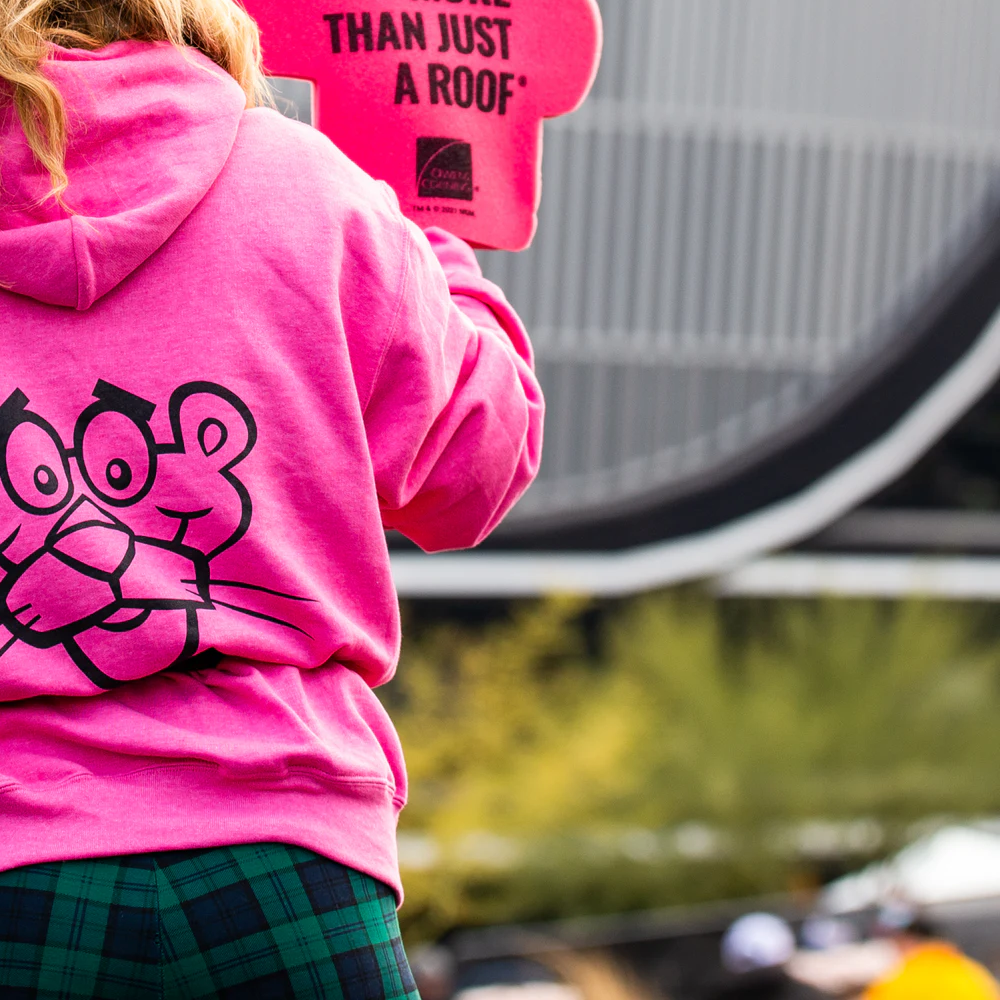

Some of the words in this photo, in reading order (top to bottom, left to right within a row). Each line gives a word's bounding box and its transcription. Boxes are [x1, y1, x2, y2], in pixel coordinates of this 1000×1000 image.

[323, 12, 427, 54] THAN
[438, 13, 512, 60] JUST
[394, 62, 419, 105] A
